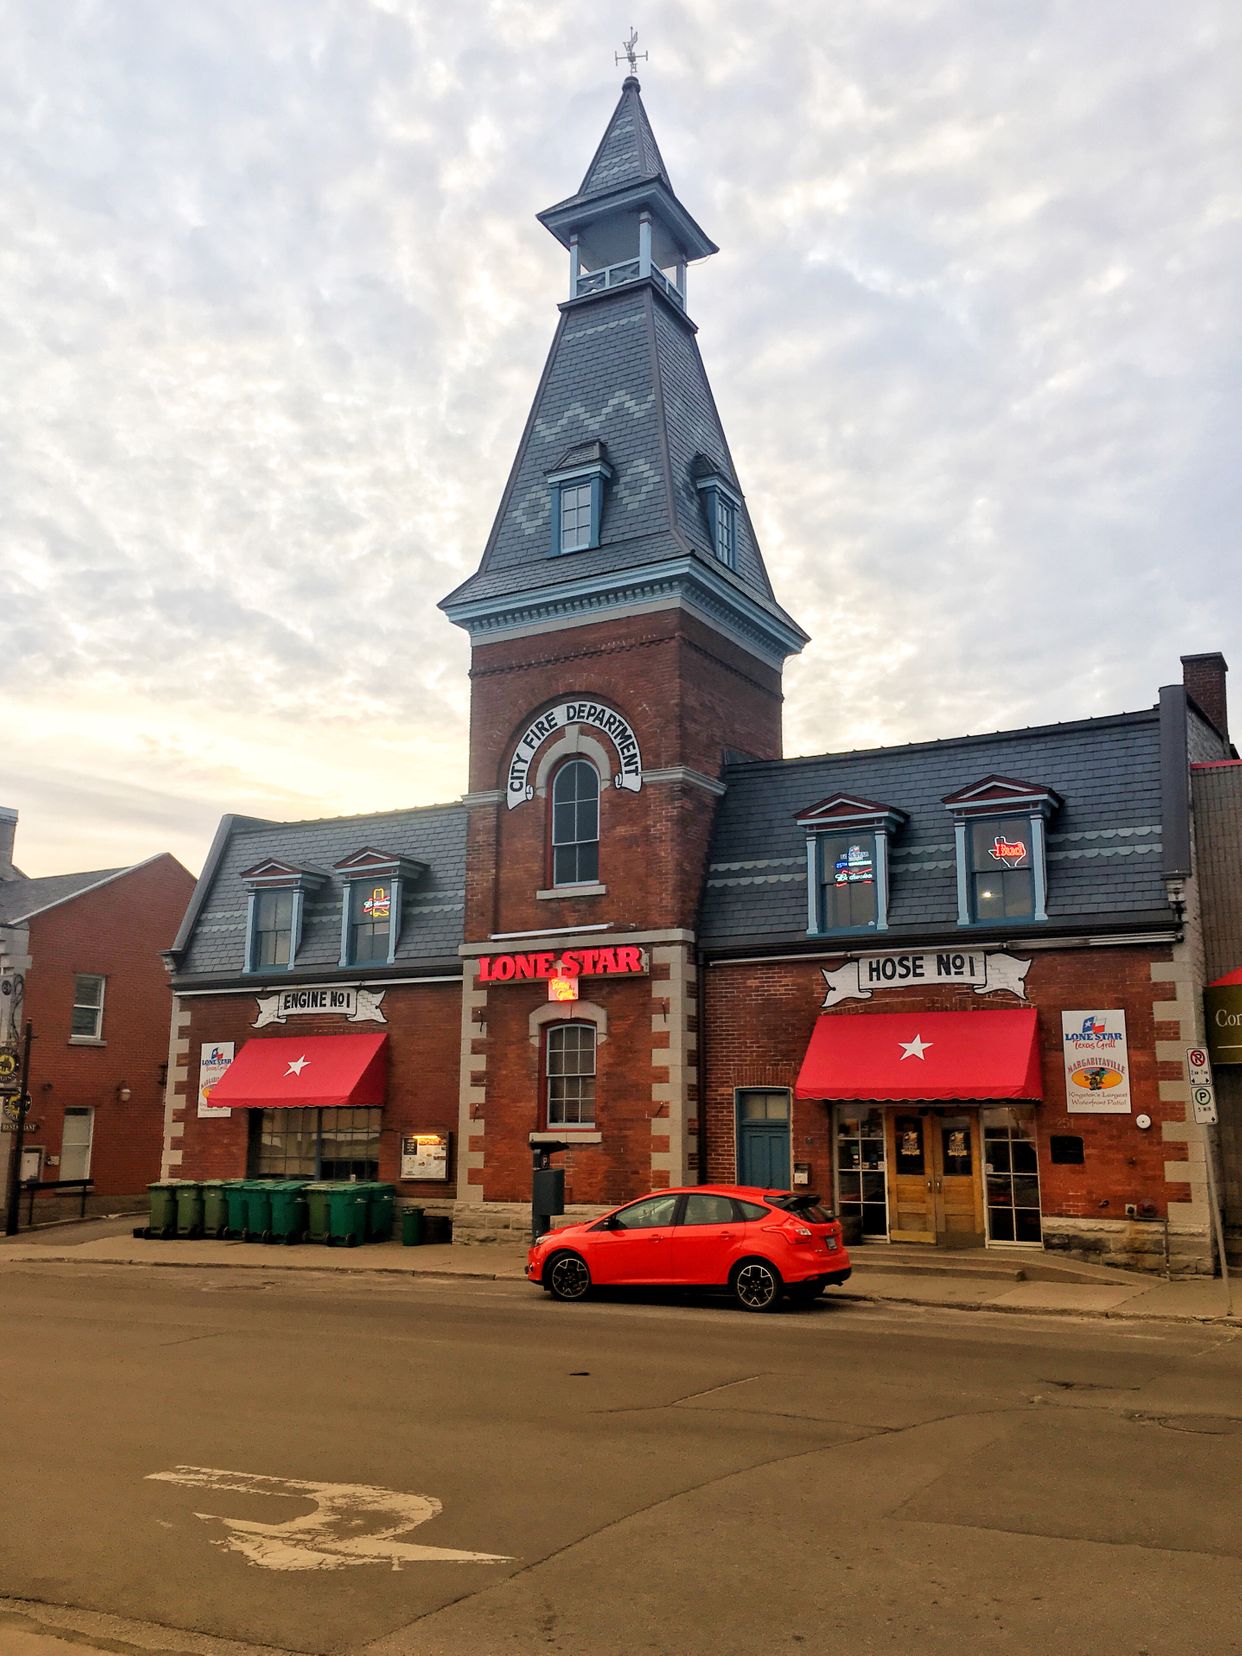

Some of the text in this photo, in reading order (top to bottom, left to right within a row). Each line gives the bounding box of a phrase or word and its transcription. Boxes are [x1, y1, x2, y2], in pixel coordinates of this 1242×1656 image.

[510, 703, 640, 792] CITY FIRE DEPARTMENT
[479, 952, 558, 982] LONE
[560, 946, 642, 977] STAR
[868, 956, 925, 982] HOSE
[284, 991, 327, 1010] ENGINE
[1065, 1032, 1122, 1041] LONE STAR
[1073, 1039, 1116, 1050] Texas Grill
[1067, 1057, 1126, 1075] MARGARITAVILLE
